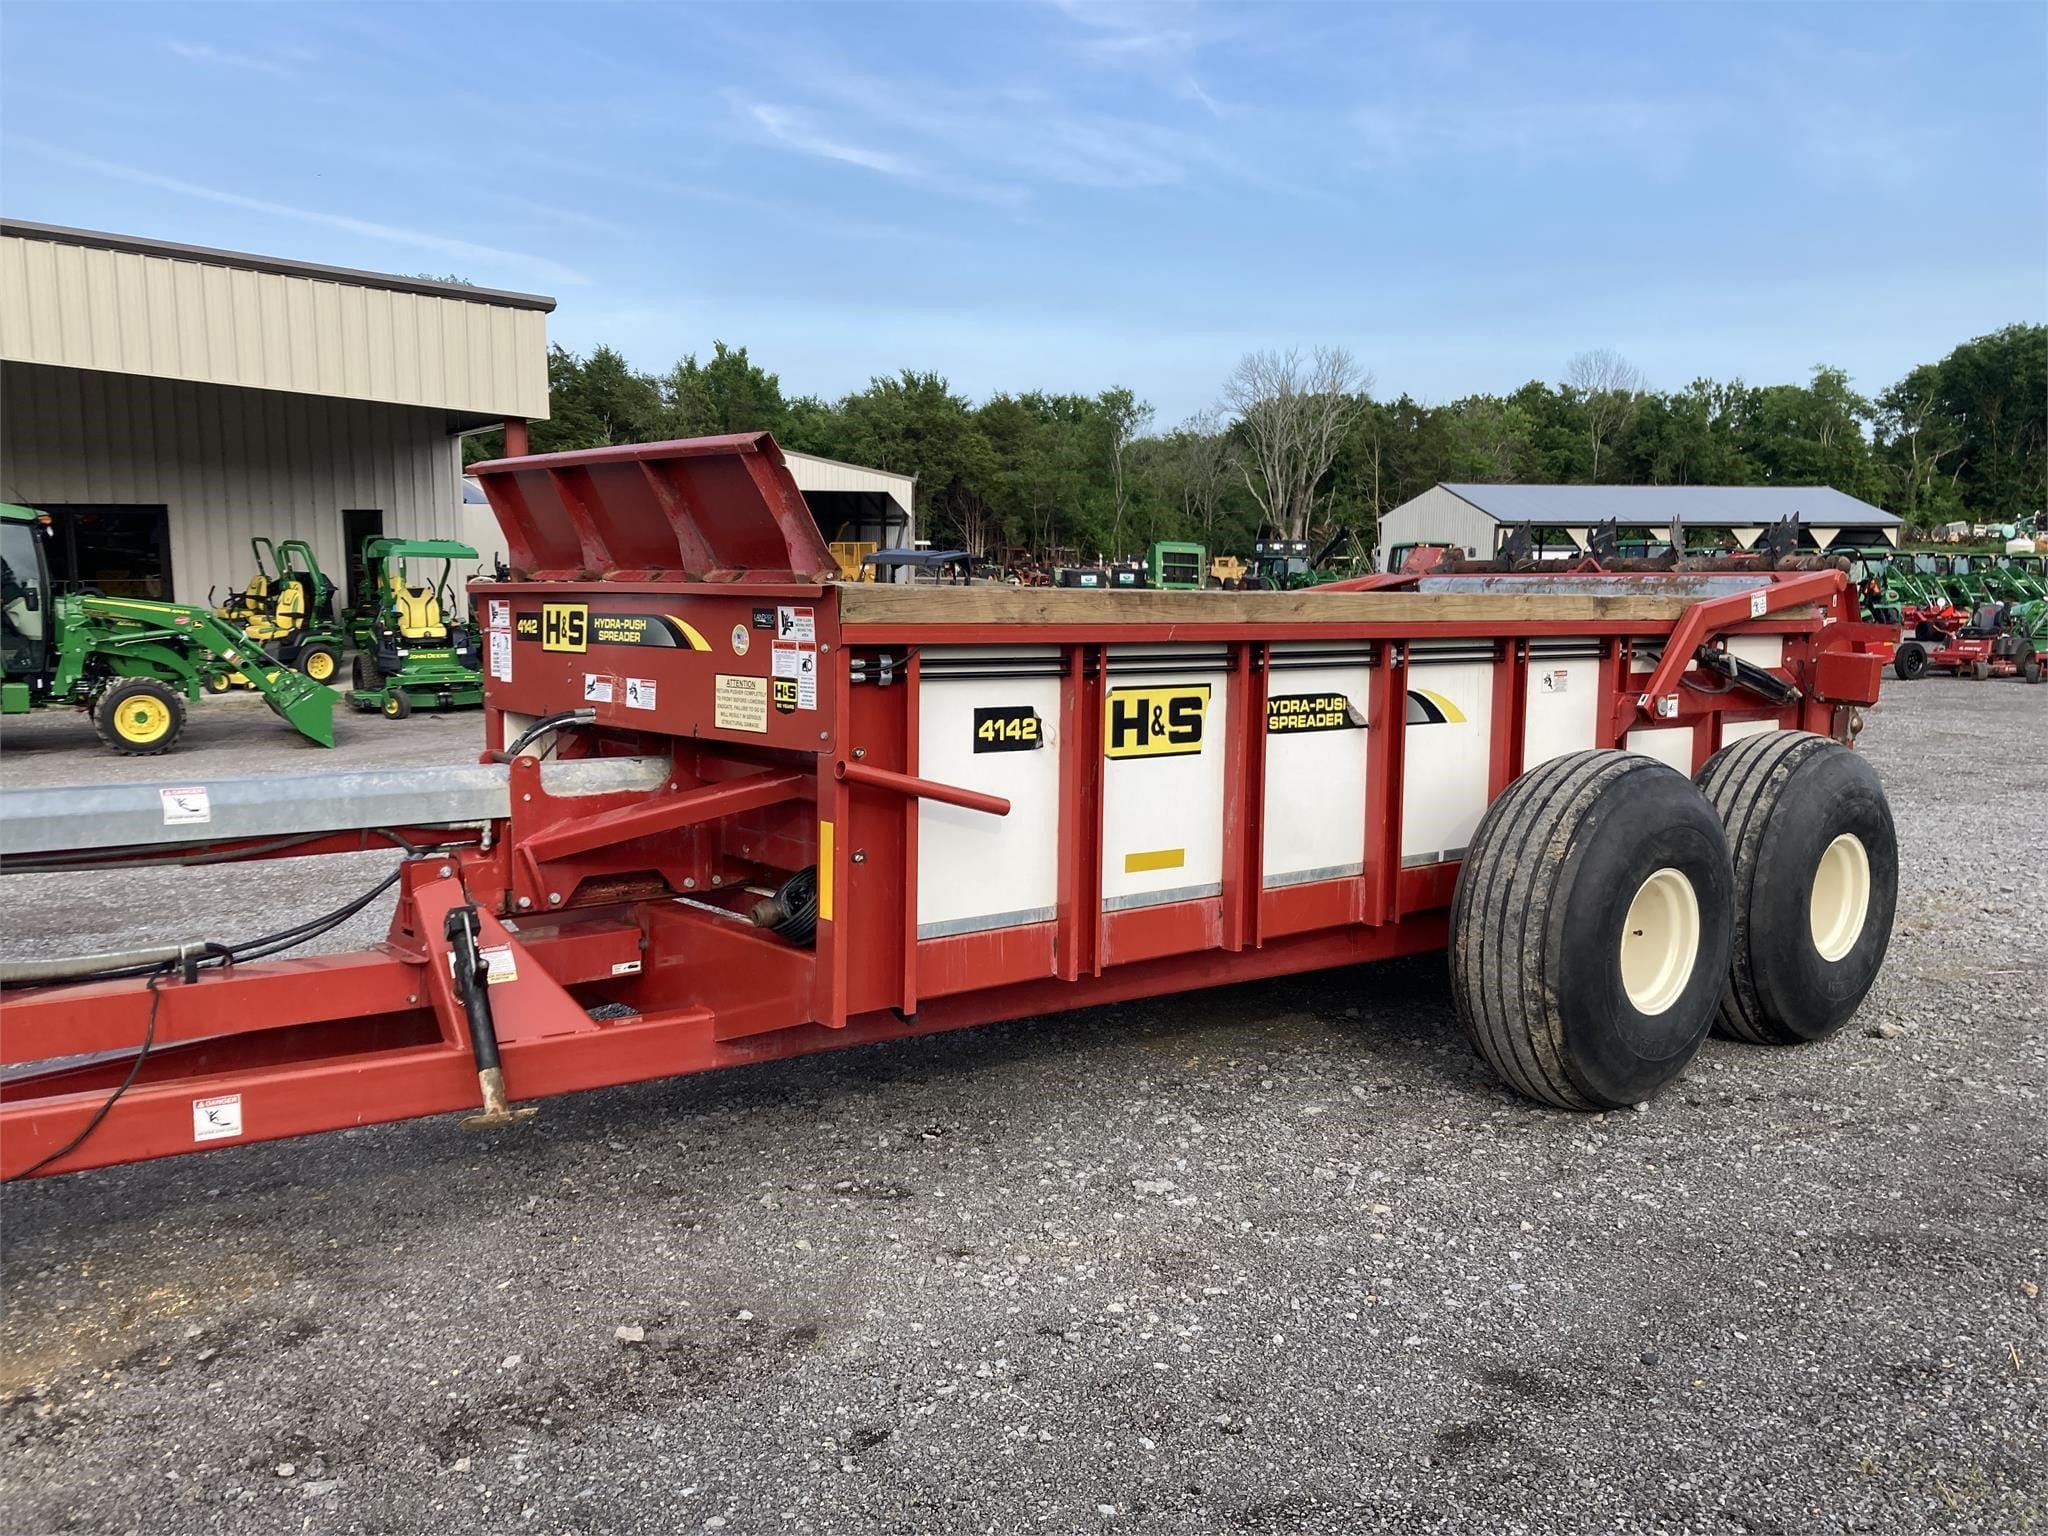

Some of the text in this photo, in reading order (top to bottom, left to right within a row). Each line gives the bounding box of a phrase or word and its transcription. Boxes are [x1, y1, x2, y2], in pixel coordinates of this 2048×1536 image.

[517, 619, 538, 634] 4142
[546, 610, 584, 646] H&S
[594, 618, 647, 630] HYDRA-PUSH
[598, 630, 641, 643] SPREADER
[726, 679, 756, 688] ATTENTION
[775, 684, 796, 699] H&S
[1111, 696, 1203, 748] H&S
[1269, 713, 1343, 730] SPREADER
[978, 717, 1037, 742] 4142
[205, 1096, 238, 1107] DANGER
